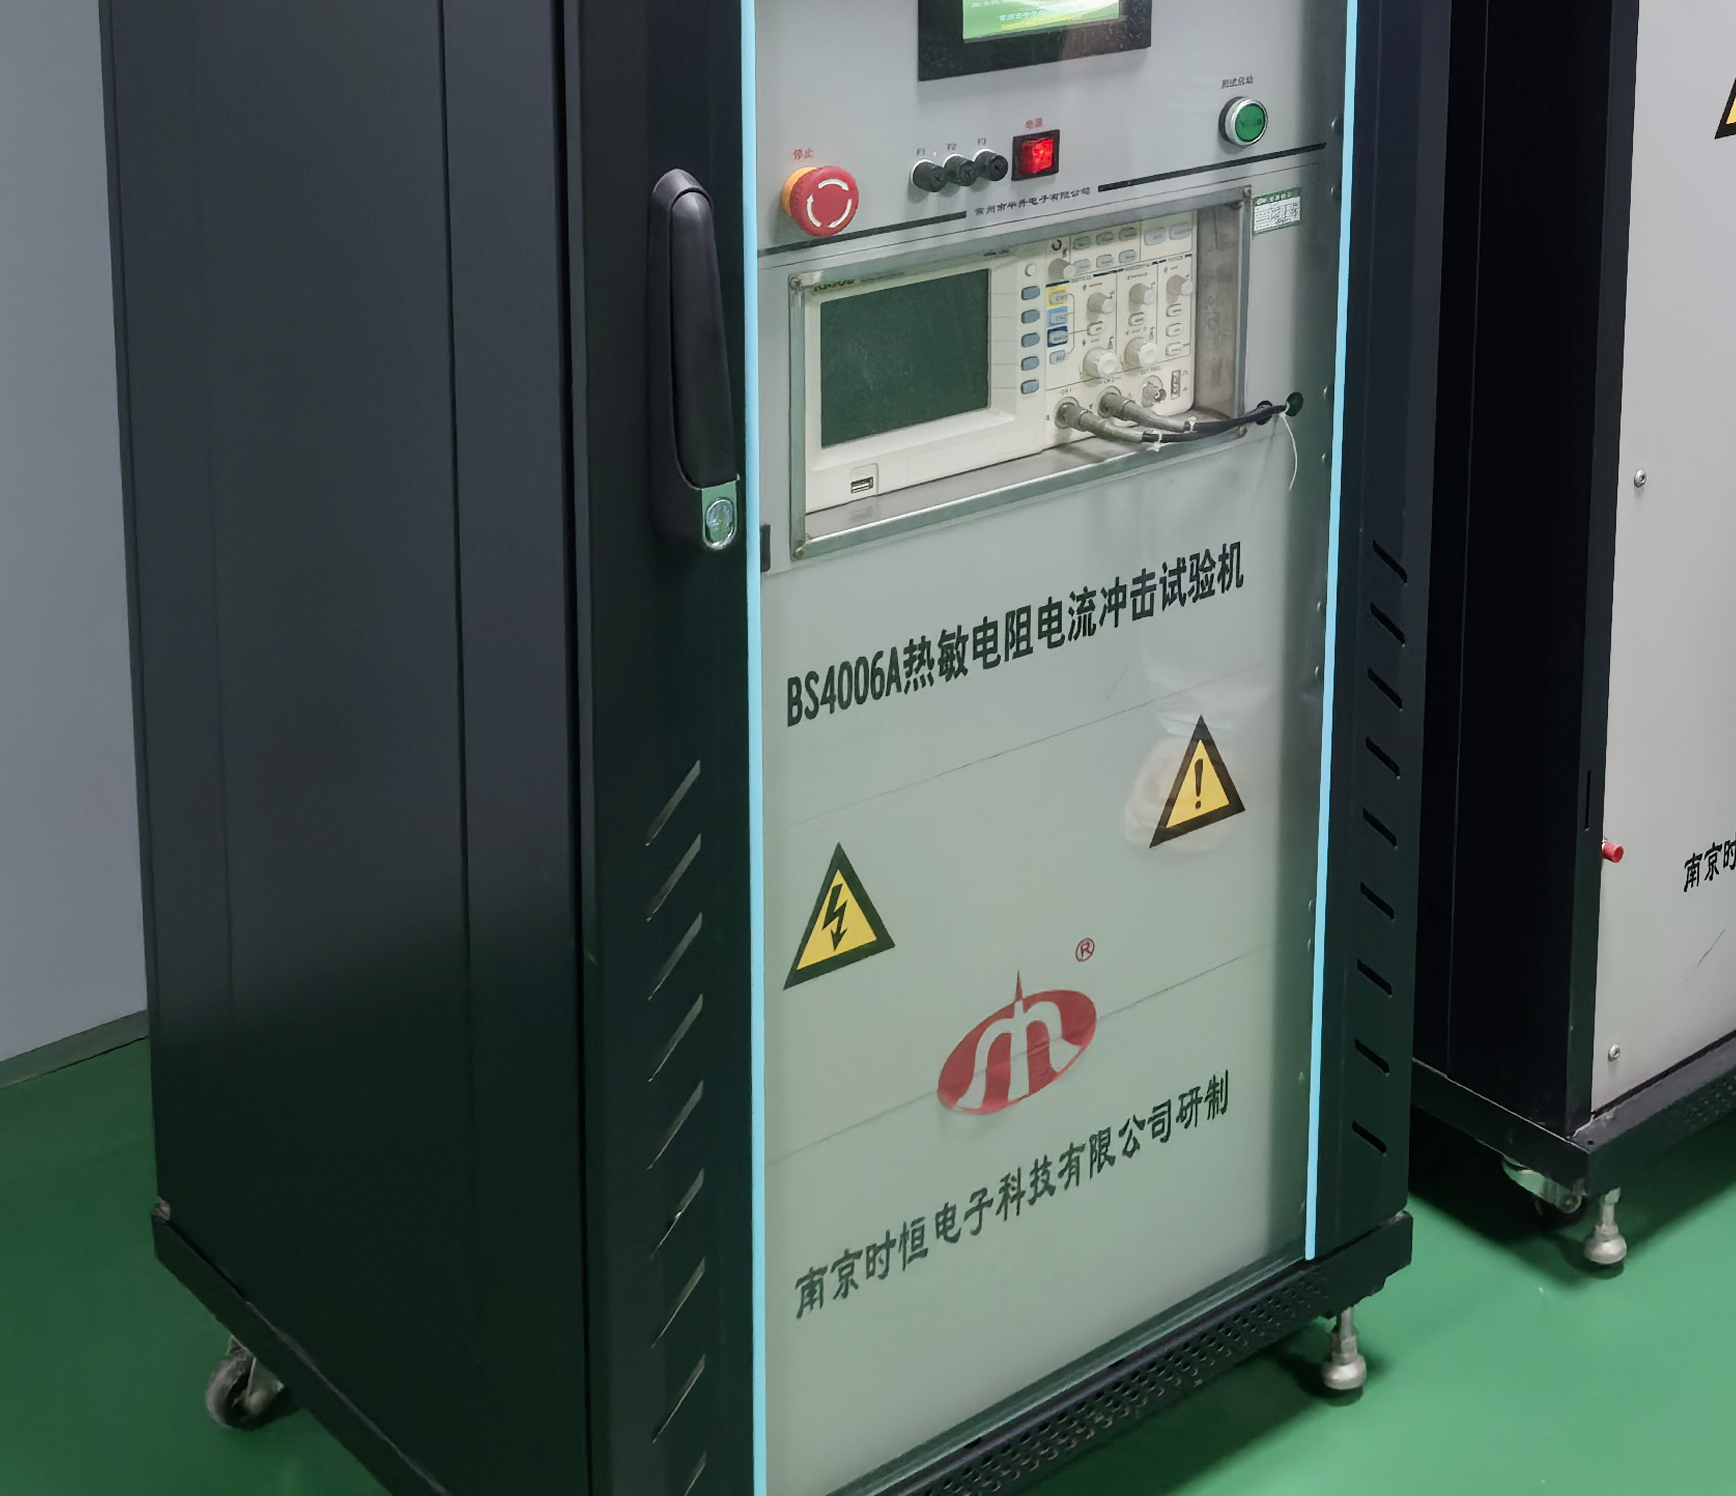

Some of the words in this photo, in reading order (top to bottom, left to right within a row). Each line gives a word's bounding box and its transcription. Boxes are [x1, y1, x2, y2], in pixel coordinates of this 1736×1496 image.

[947, 142, 957, 151] F2
[978, 137, 986, 145] F3
[793, 147, 814, 161] 停止
[917, 148, 925, 156] F1
[787, 541, 1245, 727] BS4006A热敏电阻电流冲击试验机
[795, 1069, 1229, 1320] 南京时恒电子科技有限公司研制
